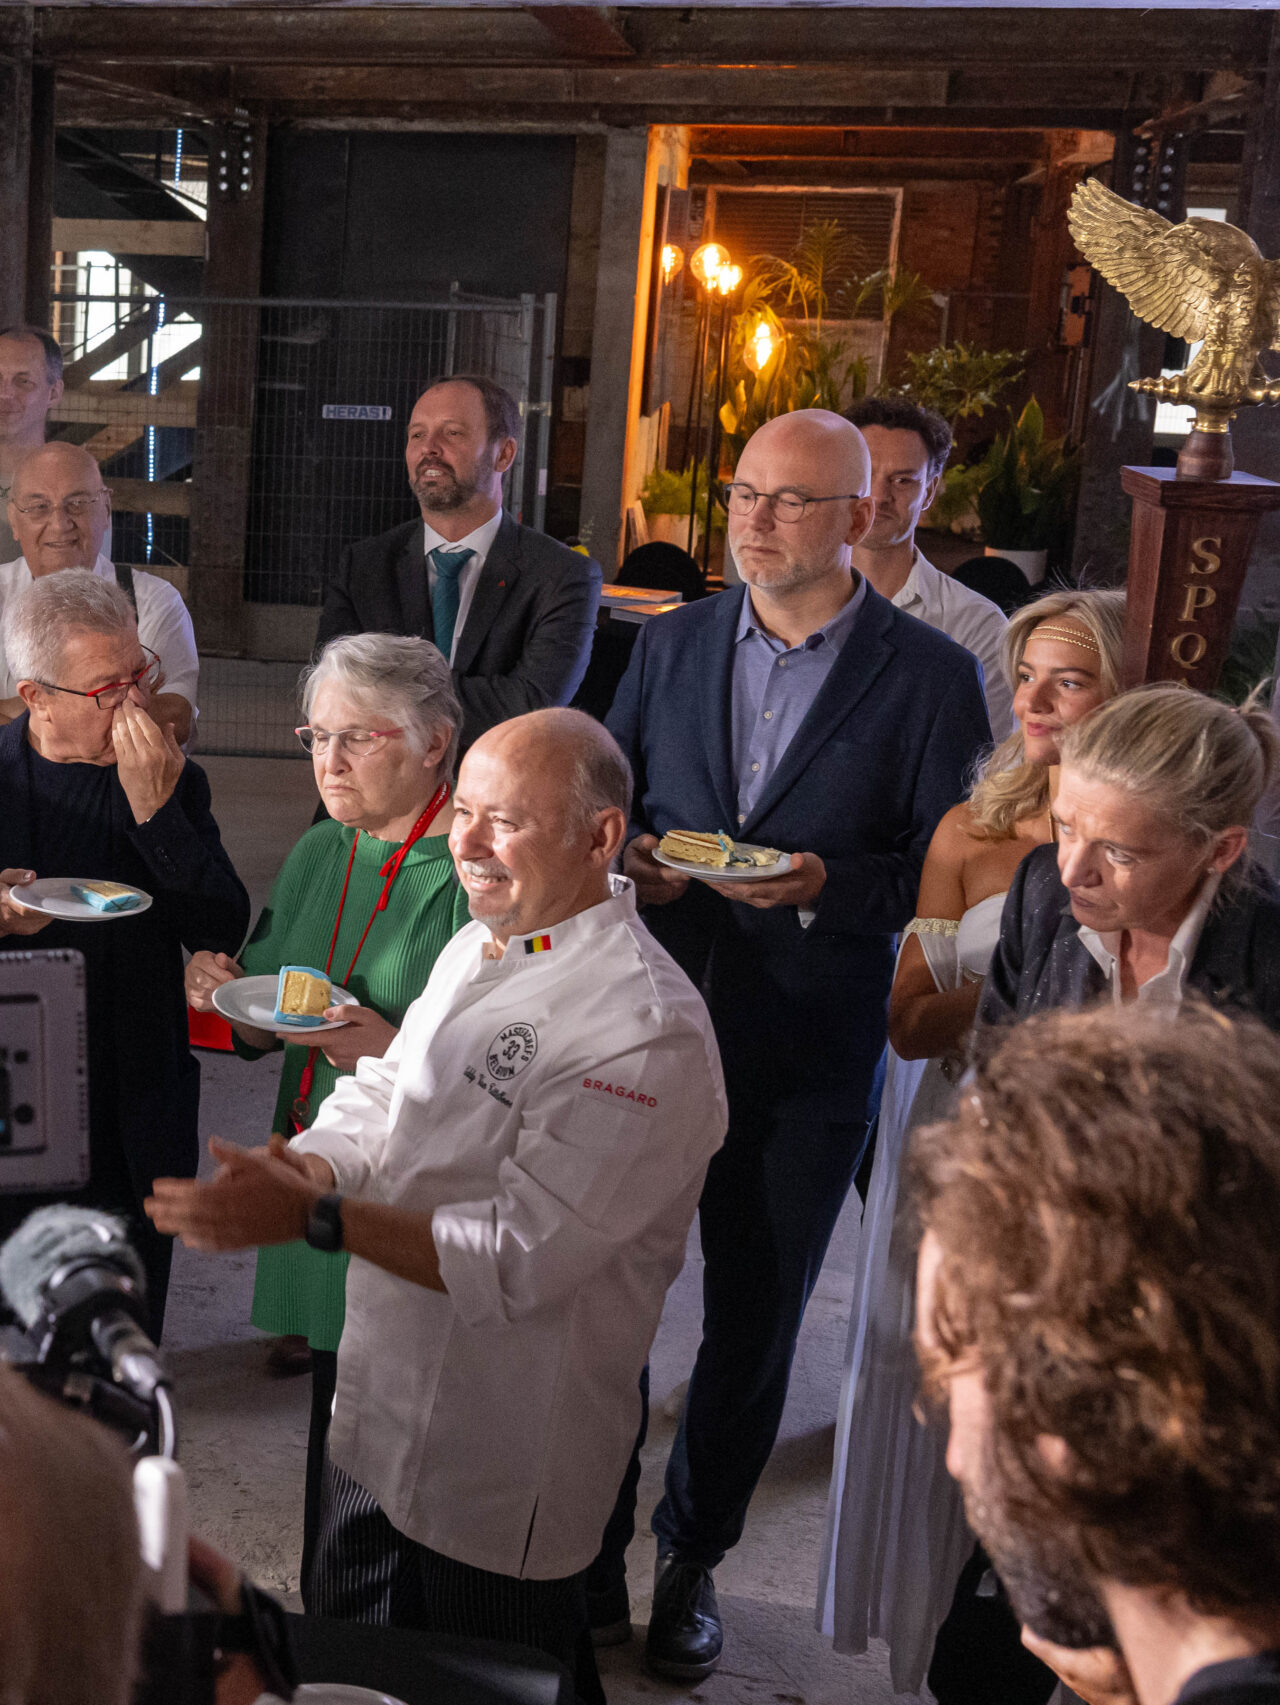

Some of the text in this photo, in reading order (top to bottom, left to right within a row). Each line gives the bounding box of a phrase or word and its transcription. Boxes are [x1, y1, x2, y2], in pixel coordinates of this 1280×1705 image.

[325, 406, 381, 419] HERAS
[502, 1040, 521, 1060] 33
[489, 1054, 515, 1077] BELGIUM
[582, 1078, 657, 1108] BRAGARD
